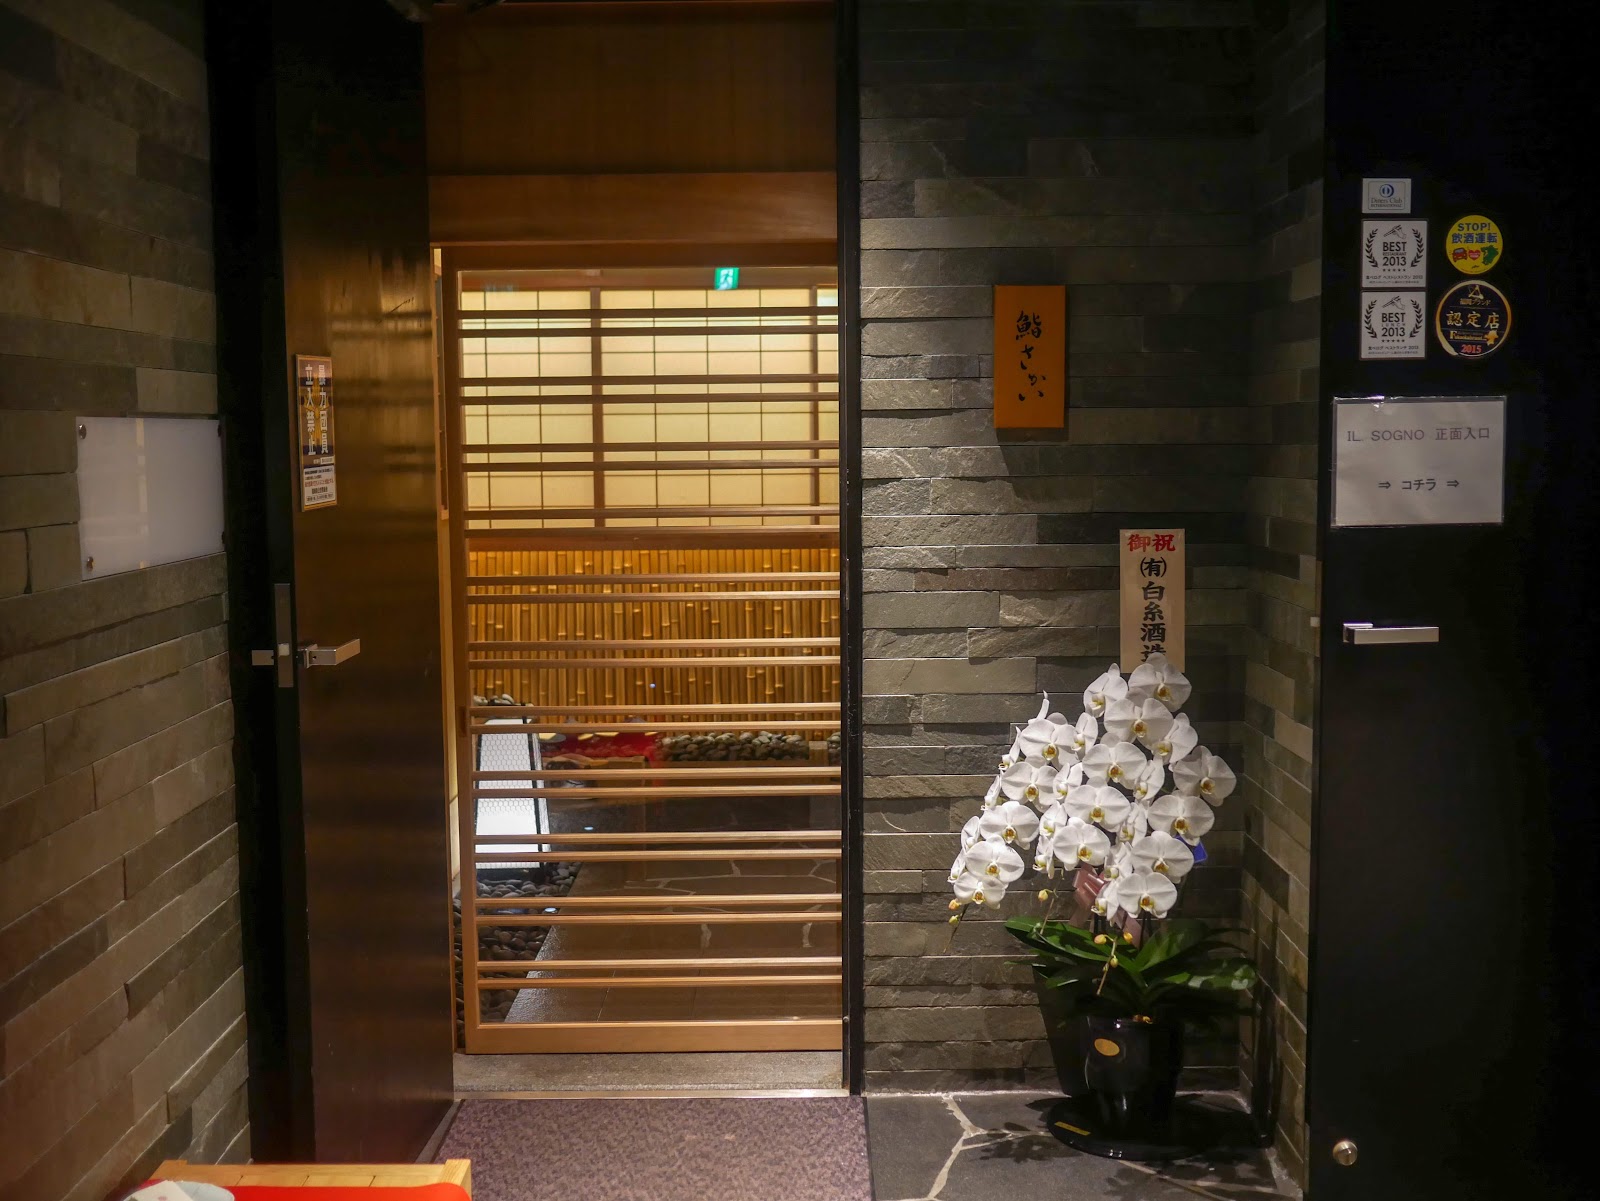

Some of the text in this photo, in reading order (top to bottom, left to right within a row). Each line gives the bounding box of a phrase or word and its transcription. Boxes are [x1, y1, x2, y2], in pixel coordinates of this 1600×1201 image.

[1457, 222, 1491, 232] STOP!
[1451, 232, 1498, 244] 飲酒運転
[1382, 241, 1407, 252] BEST
[1382, 256, 1407, 266] 2013
[1381, 312, 1406, 322] BEST
[1446, 310, 1500, 329] 認定店
[1381, 327, 1406, 337] 2013
[1461, 344, 1482, 354] 2015
[305, 363, 317, 456] 立入禁止
[1371, 429, 1425, 441] SOGNO
[1435, 427, 1490, 441] 正面入口
[1401, 478, 1437, 491] コチラ
[1127, 533, 1176, 552] 御祝
